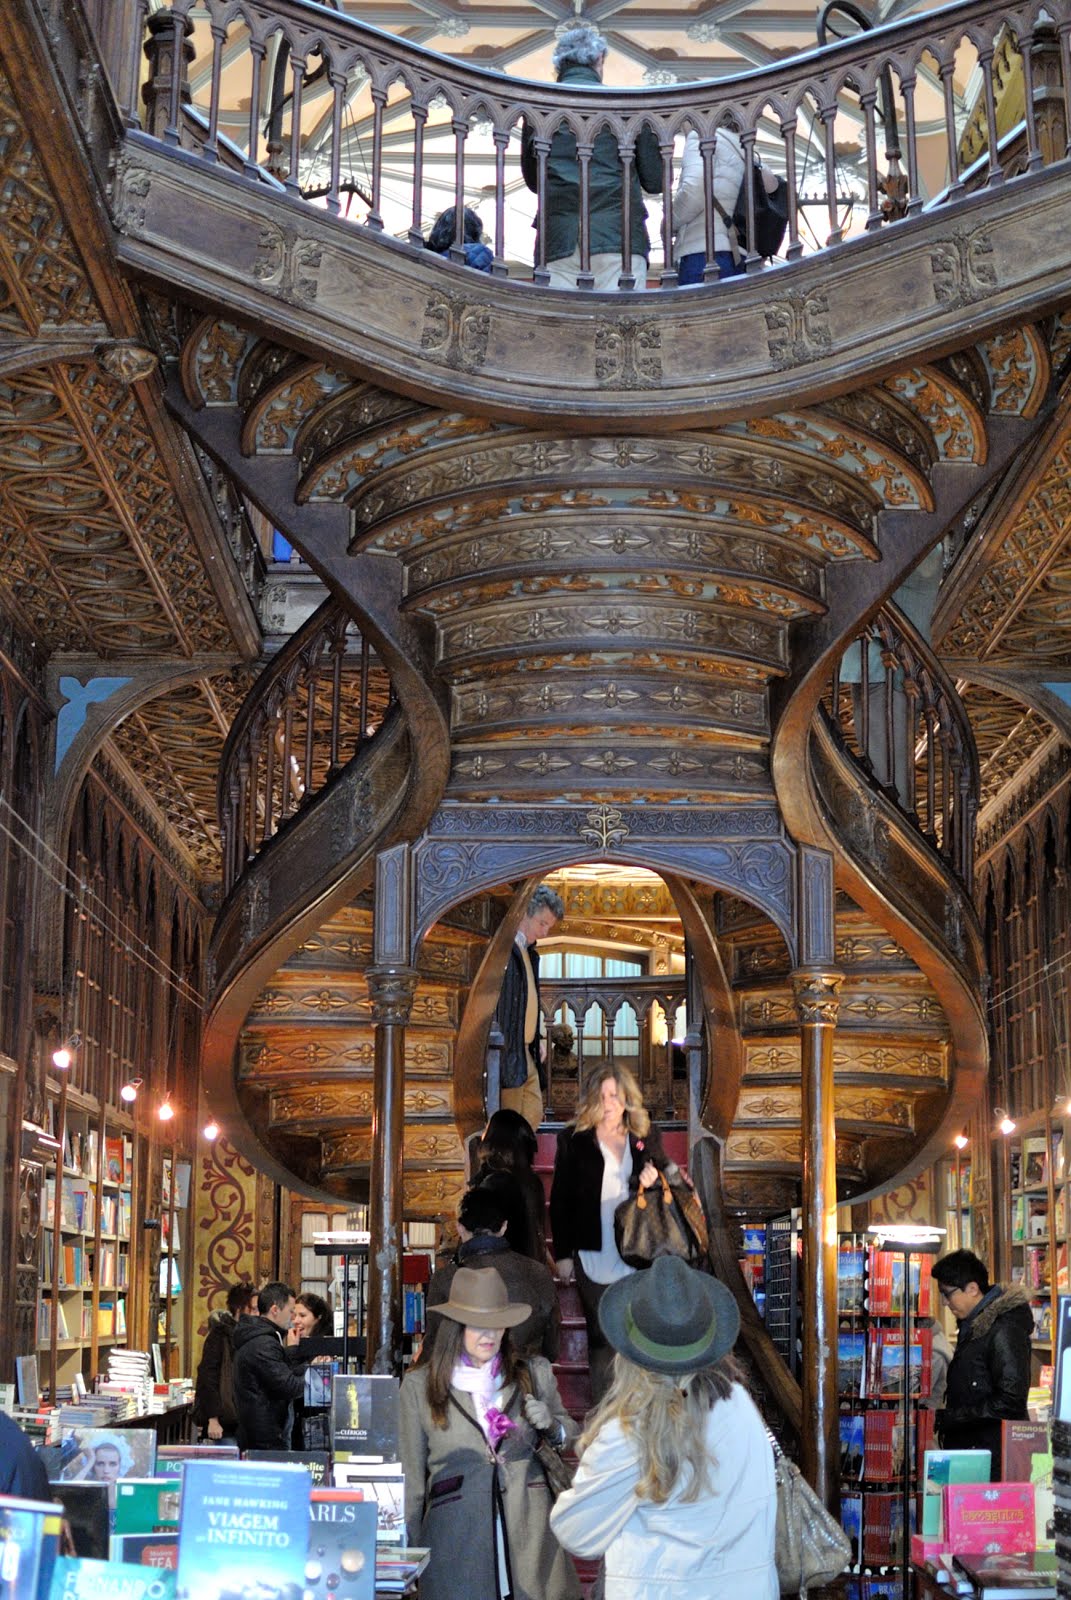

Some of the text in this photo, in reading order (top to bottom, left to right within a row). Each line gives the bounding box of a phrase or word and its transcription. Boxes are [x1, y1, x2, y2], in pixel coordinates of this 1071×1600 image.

[208, 1512, 279, 1530] VIAGEM
[207, 1530, 290, 1548] INFINITO
[149, 1557, 173, 1569] TEA
